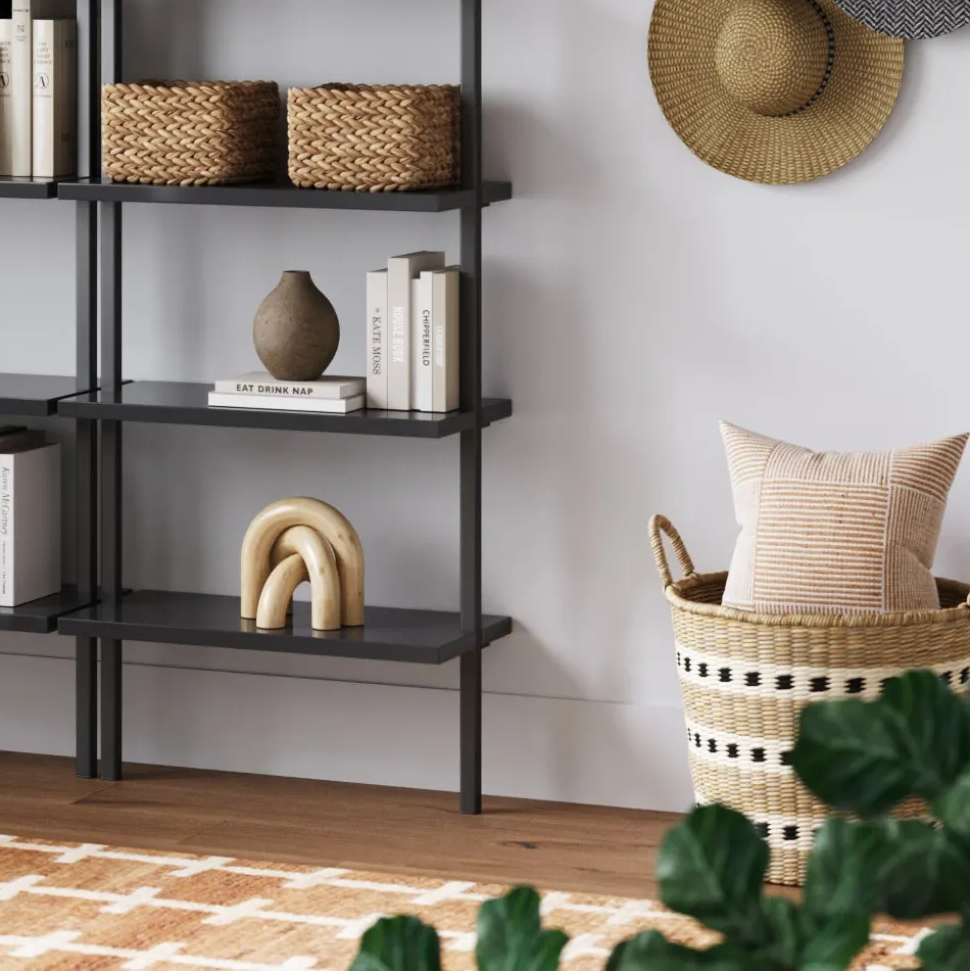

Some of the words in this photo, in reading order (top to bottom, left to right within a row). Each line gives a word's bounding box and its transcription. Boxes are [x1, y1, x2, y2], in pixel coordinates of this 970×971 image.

[372, 315, 382, 344] KATE
[392, 306, 405, 336] HOUSE
[392, 338, 405, 362] BOOK
[422, 309, 430, 367] CHIPPERFIELD
[371, 346, 382, 375] MOSS
[236, 383, 255, 393] EAT
[257, 384, 290, 395] DRINK
[292, 386, 314, 396] NAP
[1, 466, 10, 491] Karen
[0, 491, 11, 536] McCartney
